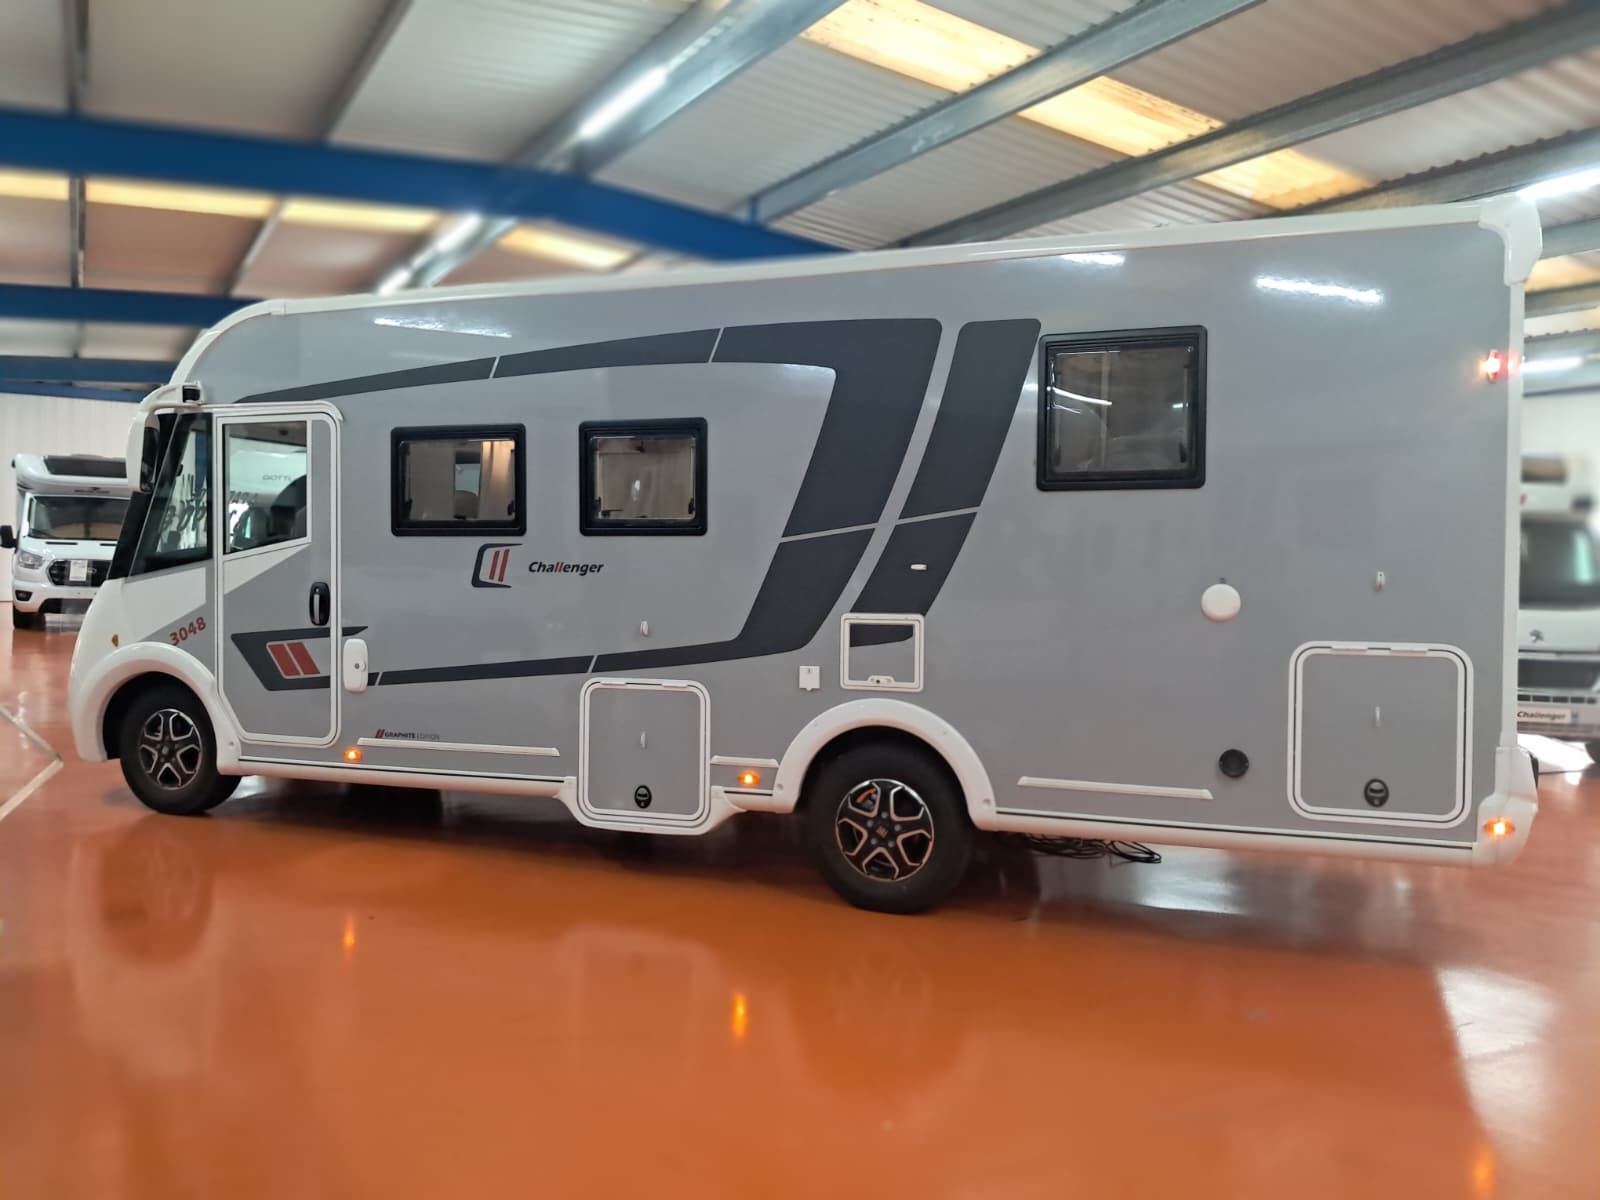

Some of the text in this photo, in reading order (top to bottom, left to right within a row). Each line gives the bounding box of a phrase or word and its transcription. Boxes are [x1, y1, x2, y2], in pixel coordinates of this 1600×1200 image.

[528, 561, 604, 576] Challenger
[169, 616, 206, 646] 3048
[384, 731, 416, 739] GRAPHITE
